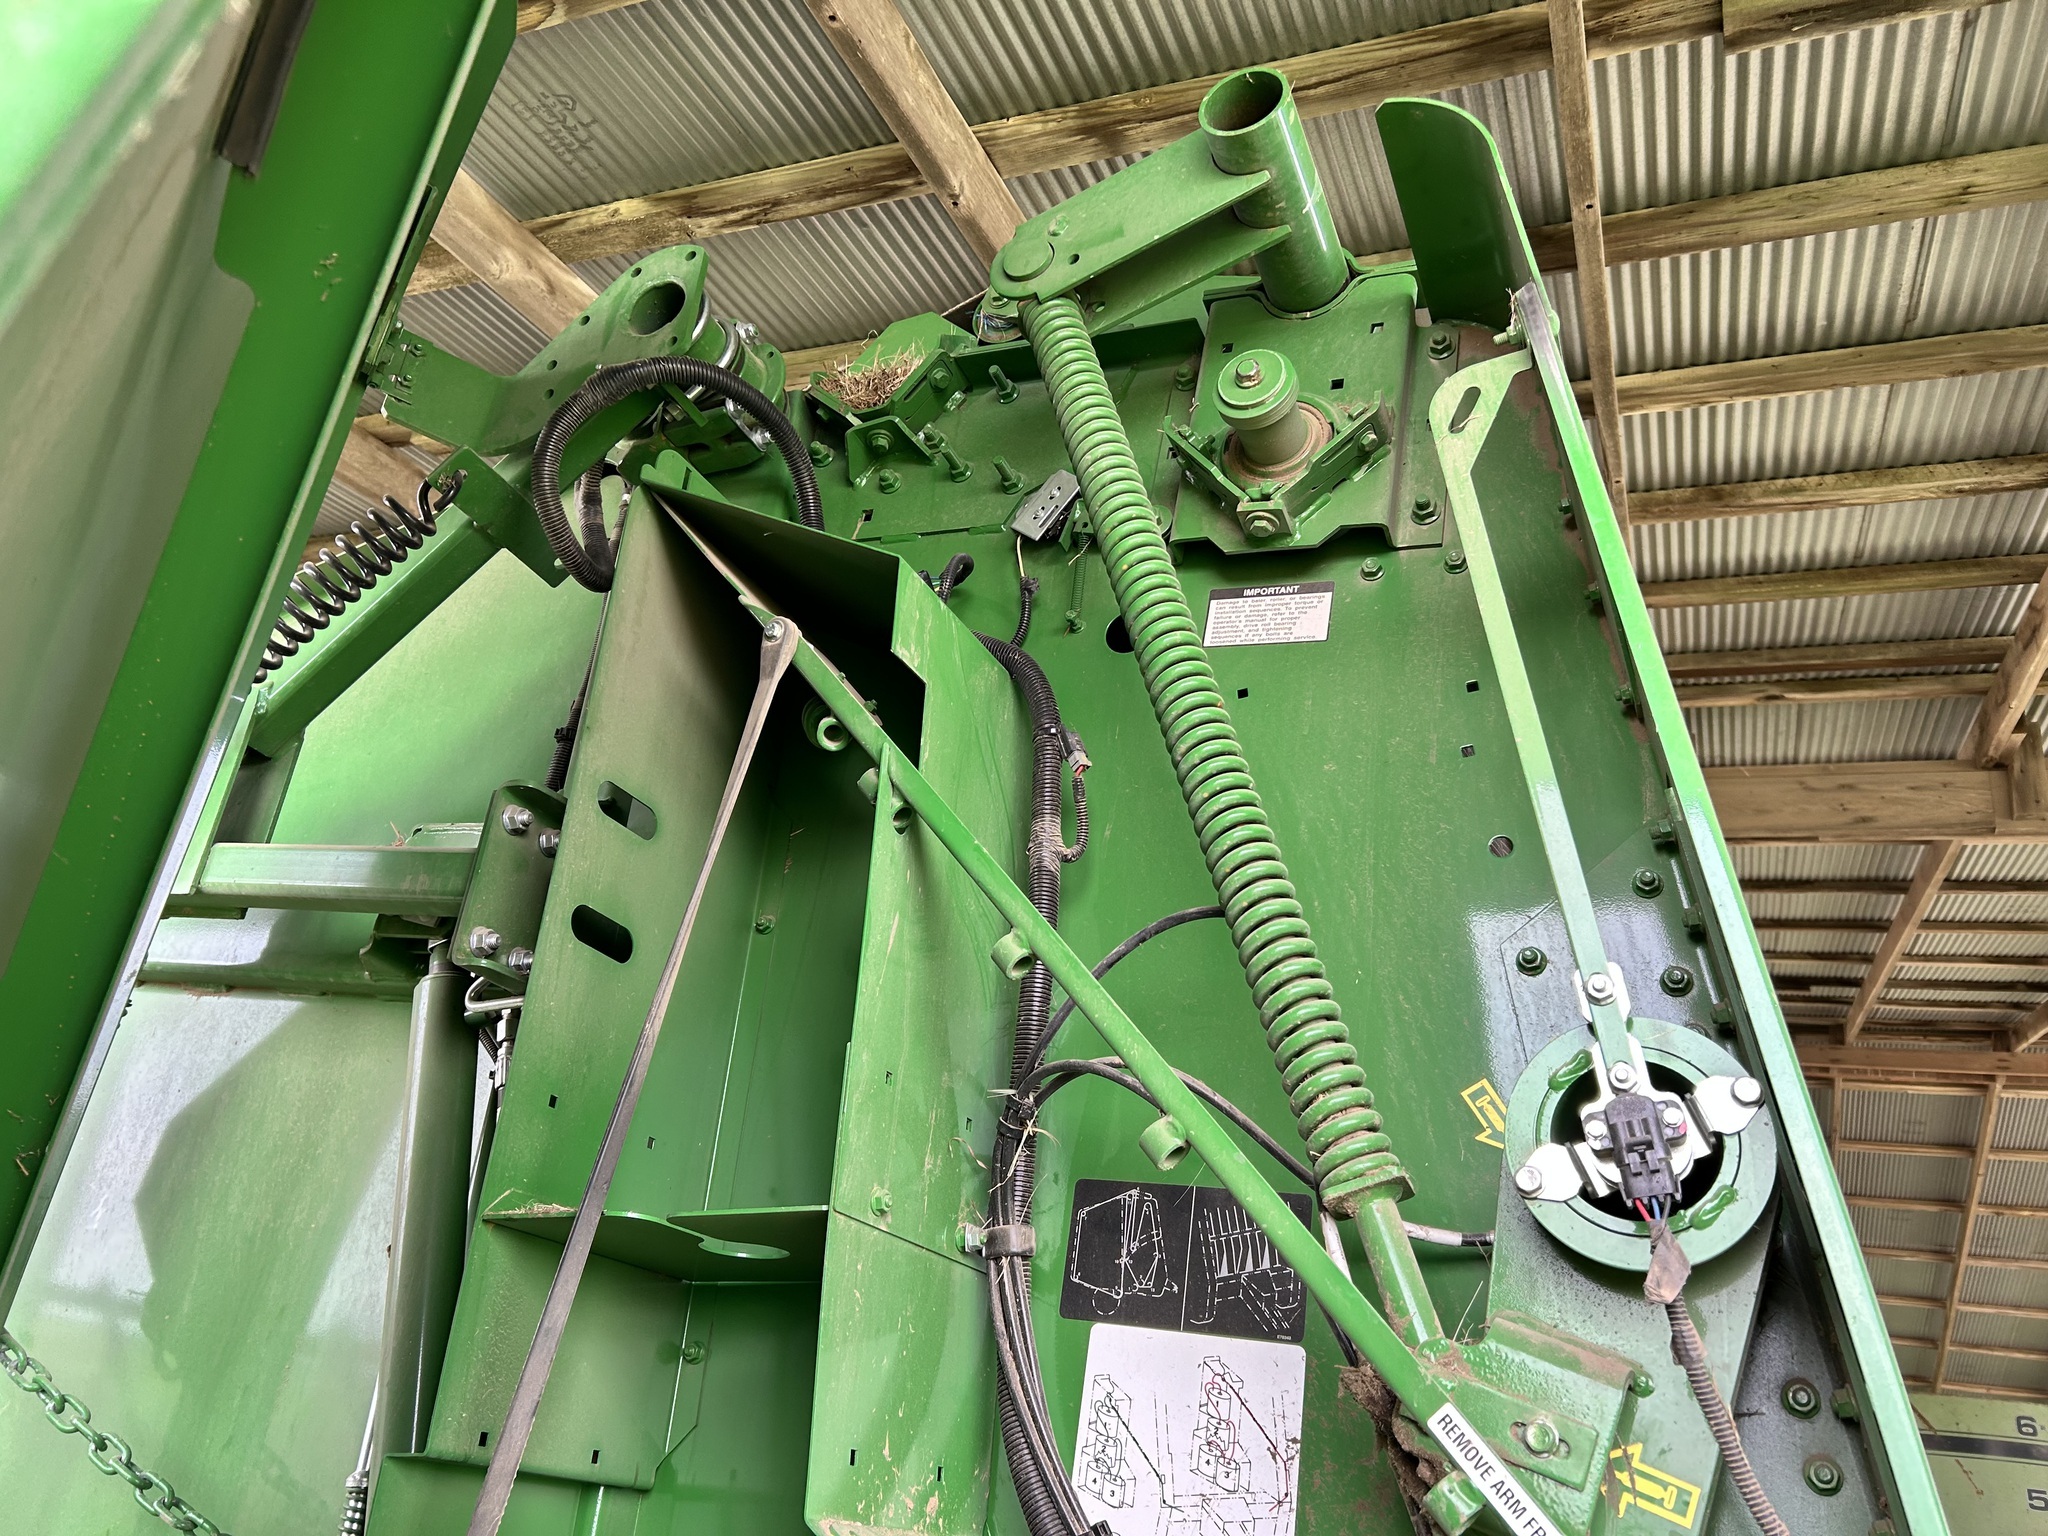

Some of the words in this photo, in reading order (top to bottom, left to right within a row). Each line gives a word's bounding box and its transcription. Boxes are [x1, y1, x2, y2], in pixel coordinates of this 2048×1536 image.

[1243, 585, 1300, 597] IMPORTANT
[1215, 1400, 1219, 1408] 1
[2016, 1415, 2039, 1437] 6
[1213, 1426, 1220, 1436] 2
[1101, 1445, 1107, 1454] 2
[1204, 1458, 1211, 1467] 4
[1437, 1413, 1496, 1482] REMOVE
[1490, 1480, 1527, 1520] ARM
[1224, 1471, 1230, 1479] 3
[1091, 1477, 1098, 1485] 4
[1109, 1489, 1115, 1498] 3
[2026, 1488, 2048, 1512] 5
